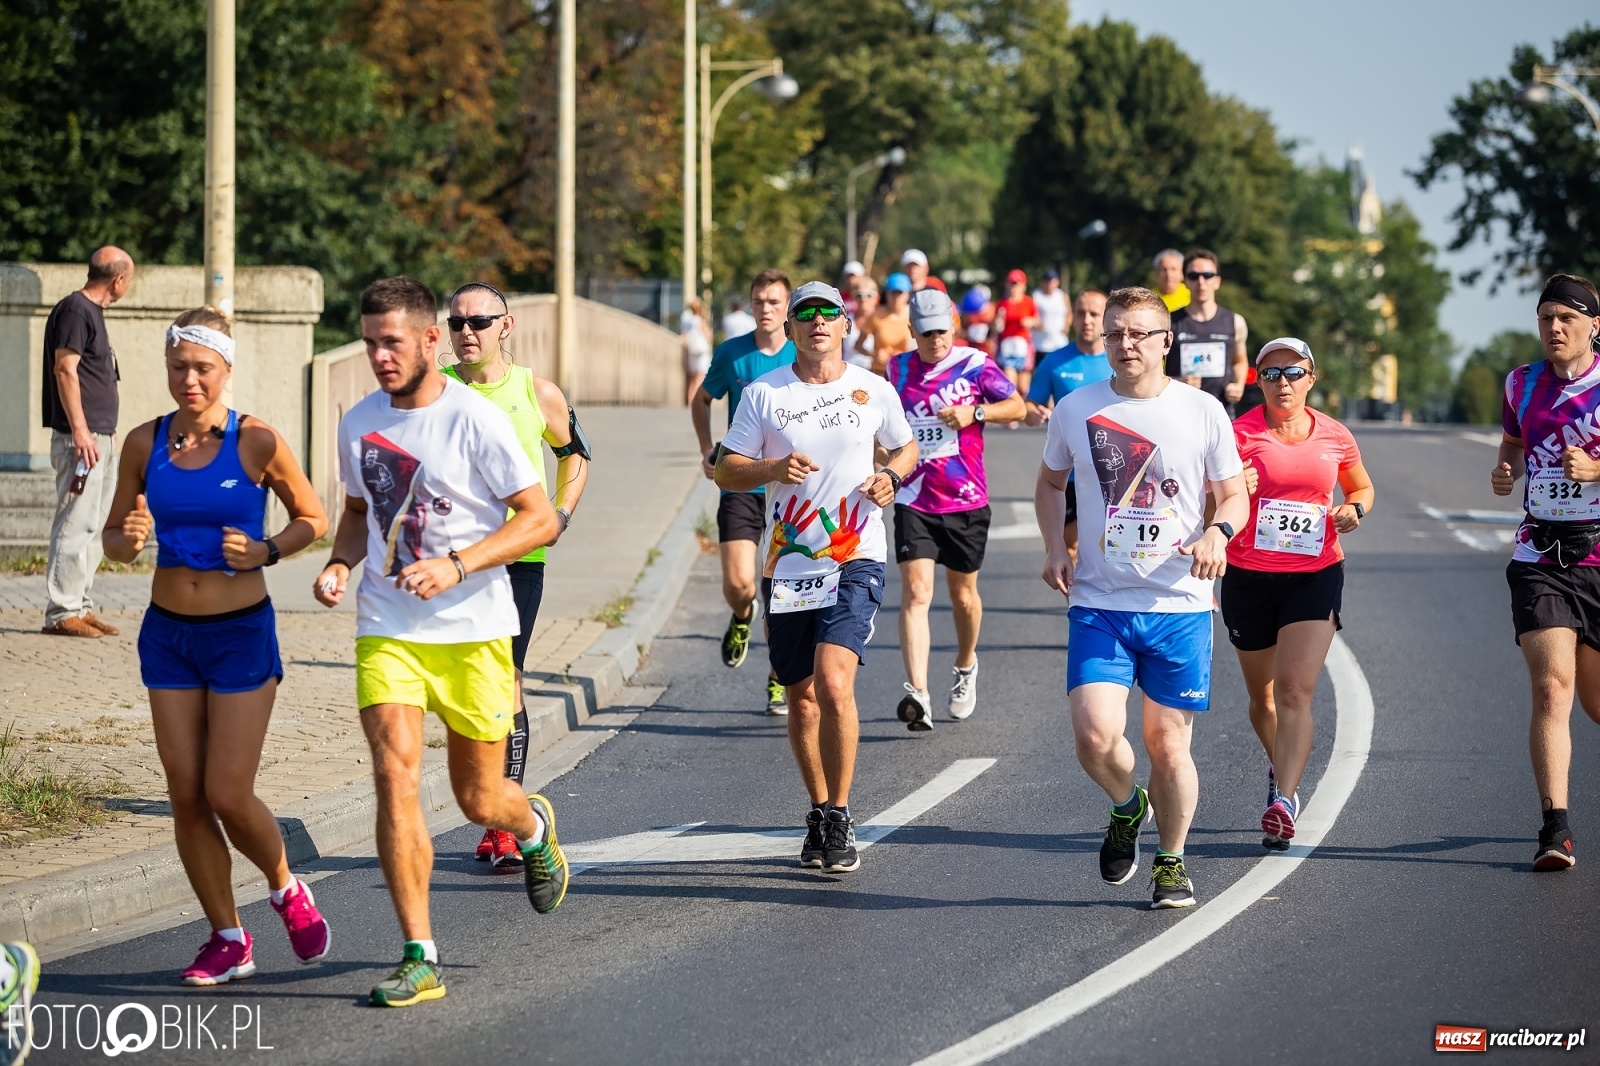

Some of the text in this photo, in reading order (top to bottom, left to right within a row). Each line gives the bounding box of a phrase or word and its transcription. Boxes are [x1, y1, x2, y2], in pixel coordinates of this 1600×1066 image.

[918, 427, 943, 442] 333
[1549, 482, 1582, 499] 332
[1137, 524, 1160, 541] 19
[1278, 514, 1312, 534] 362
[794, 576, 826, 592] 338
[508, 728, 527, 779] alenji
